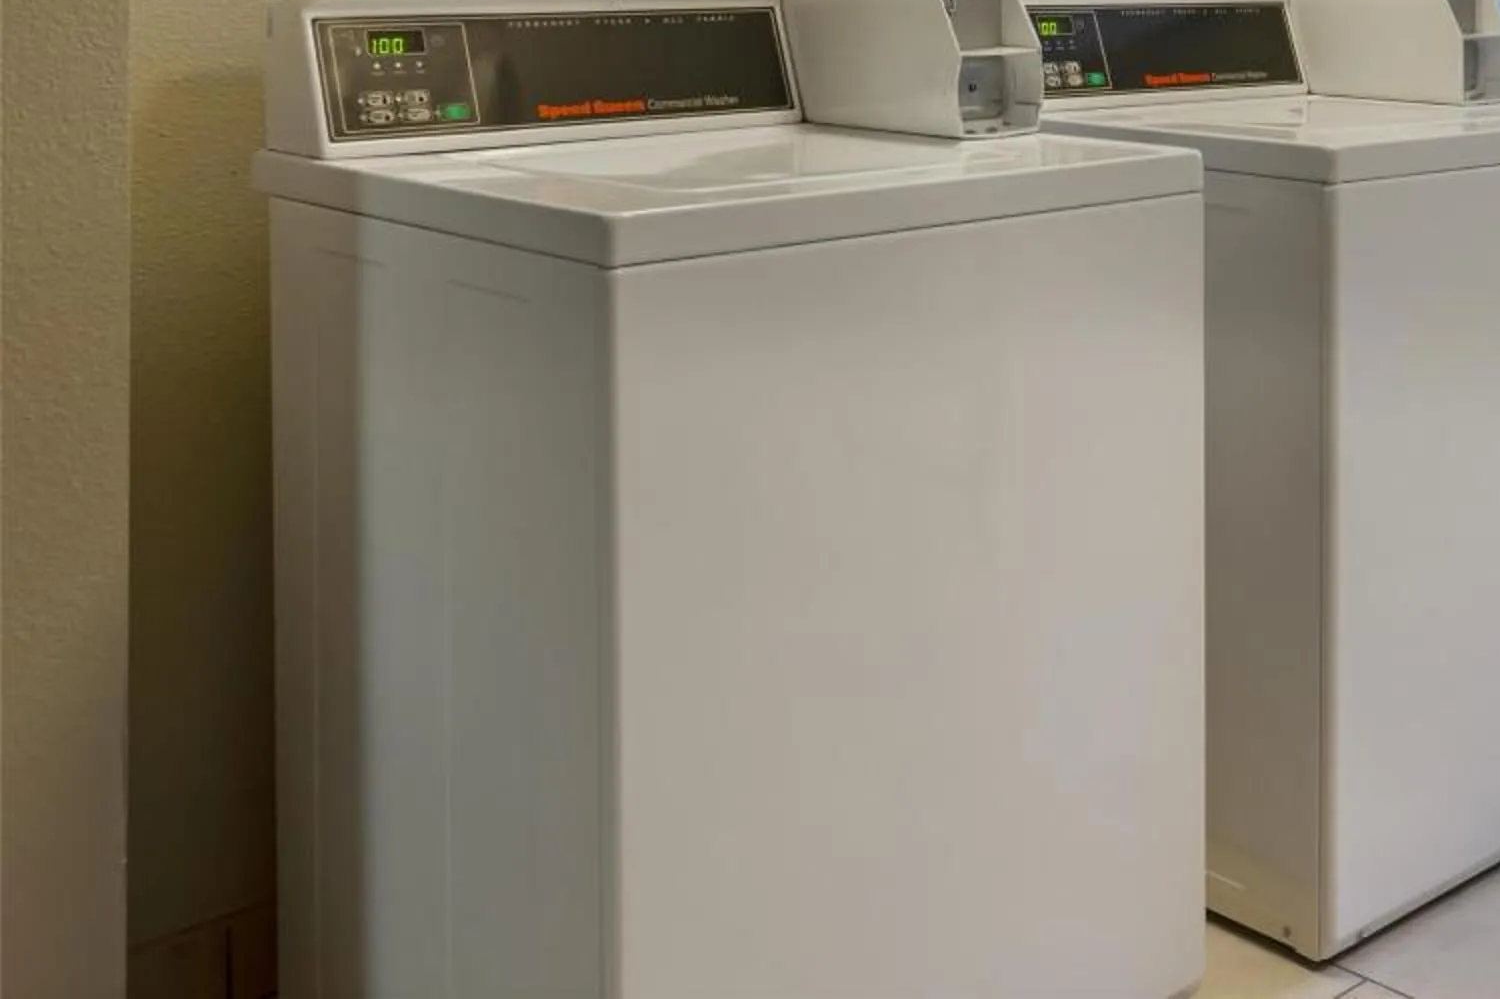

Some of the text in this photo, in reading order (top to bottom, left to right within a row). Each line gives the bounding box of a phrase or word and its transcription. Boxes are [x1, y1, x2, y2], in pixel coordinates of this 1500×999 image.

[372, 36, 405, 54] 100
[536, 99, 592, 120] Speed
[593, 97, 646, 116] Queen
